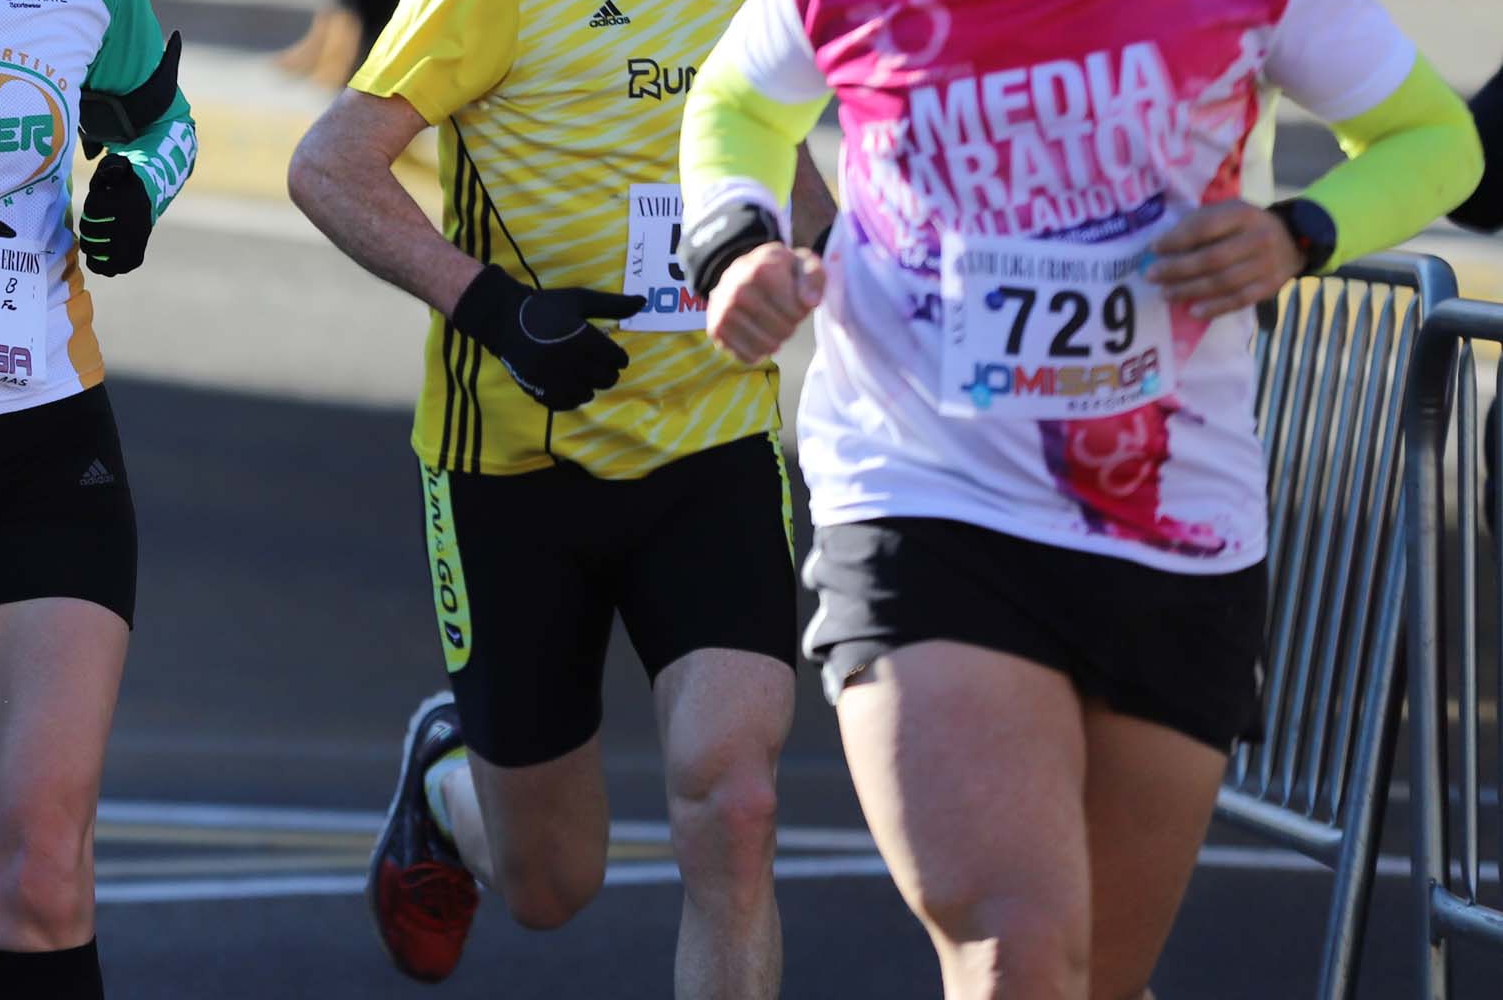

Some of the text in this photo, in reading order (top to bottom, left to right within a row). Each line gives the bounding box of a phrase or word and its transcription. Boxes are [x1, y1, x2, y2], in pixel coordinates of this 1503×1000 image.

[589, 16, 631, 28] adidas
[908, 41, 1178, 157] MEDIA
[998, 284, 1136, 357] 729
[960, 348, 1160, 396] JOMISAGA
